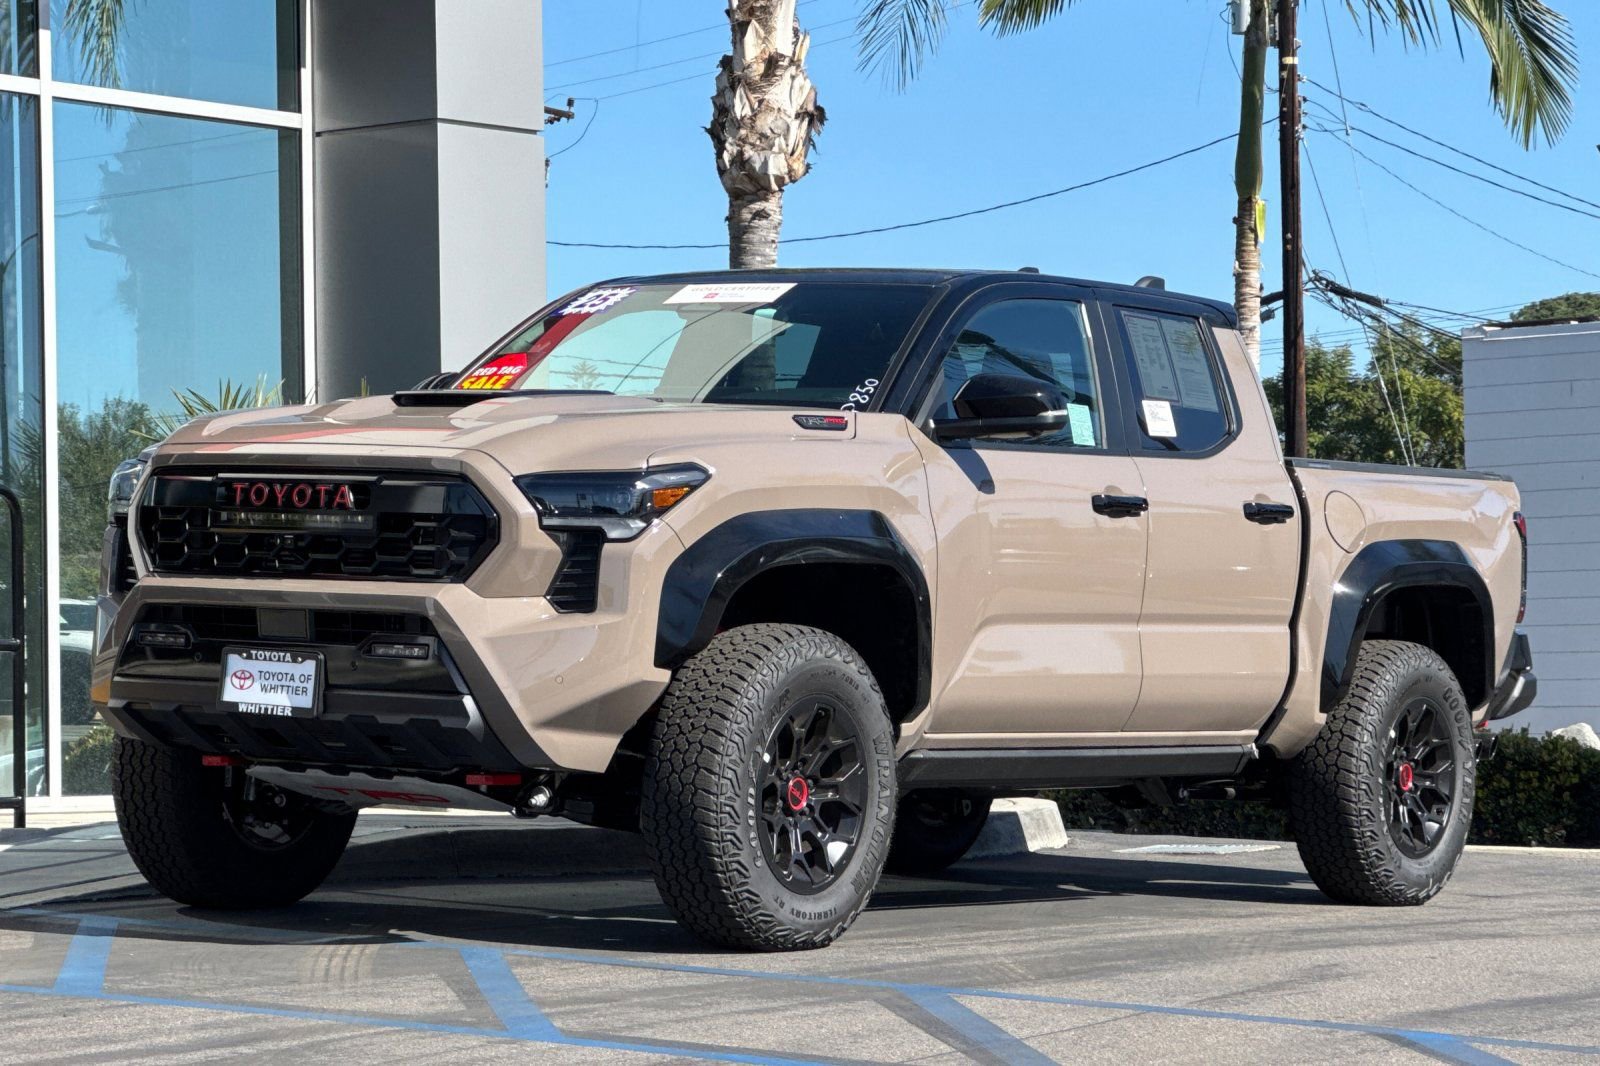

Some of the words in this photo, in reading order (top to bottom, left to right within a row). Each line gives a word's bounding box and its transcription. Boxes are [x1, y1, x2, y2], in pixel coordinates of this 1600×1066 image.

[471, 367, 498, 377] RED
[497, 365, 524, 375] TAG
[461, 375, 514, 390] SALE
[232, 483, 355, 511] TOYOTA
[250, 650, 293, 663] TOYOTA
[258, 670, 296, 683] TOYOTA
[298, 673, 313, 684] OF
[260, 683, 309, 697] WHITTIER
[238, 702, 293, 717] WHITTIER
[850, 731, 891, 895] WRANGLER
[790, 906, 838, 921] TERRITORY
